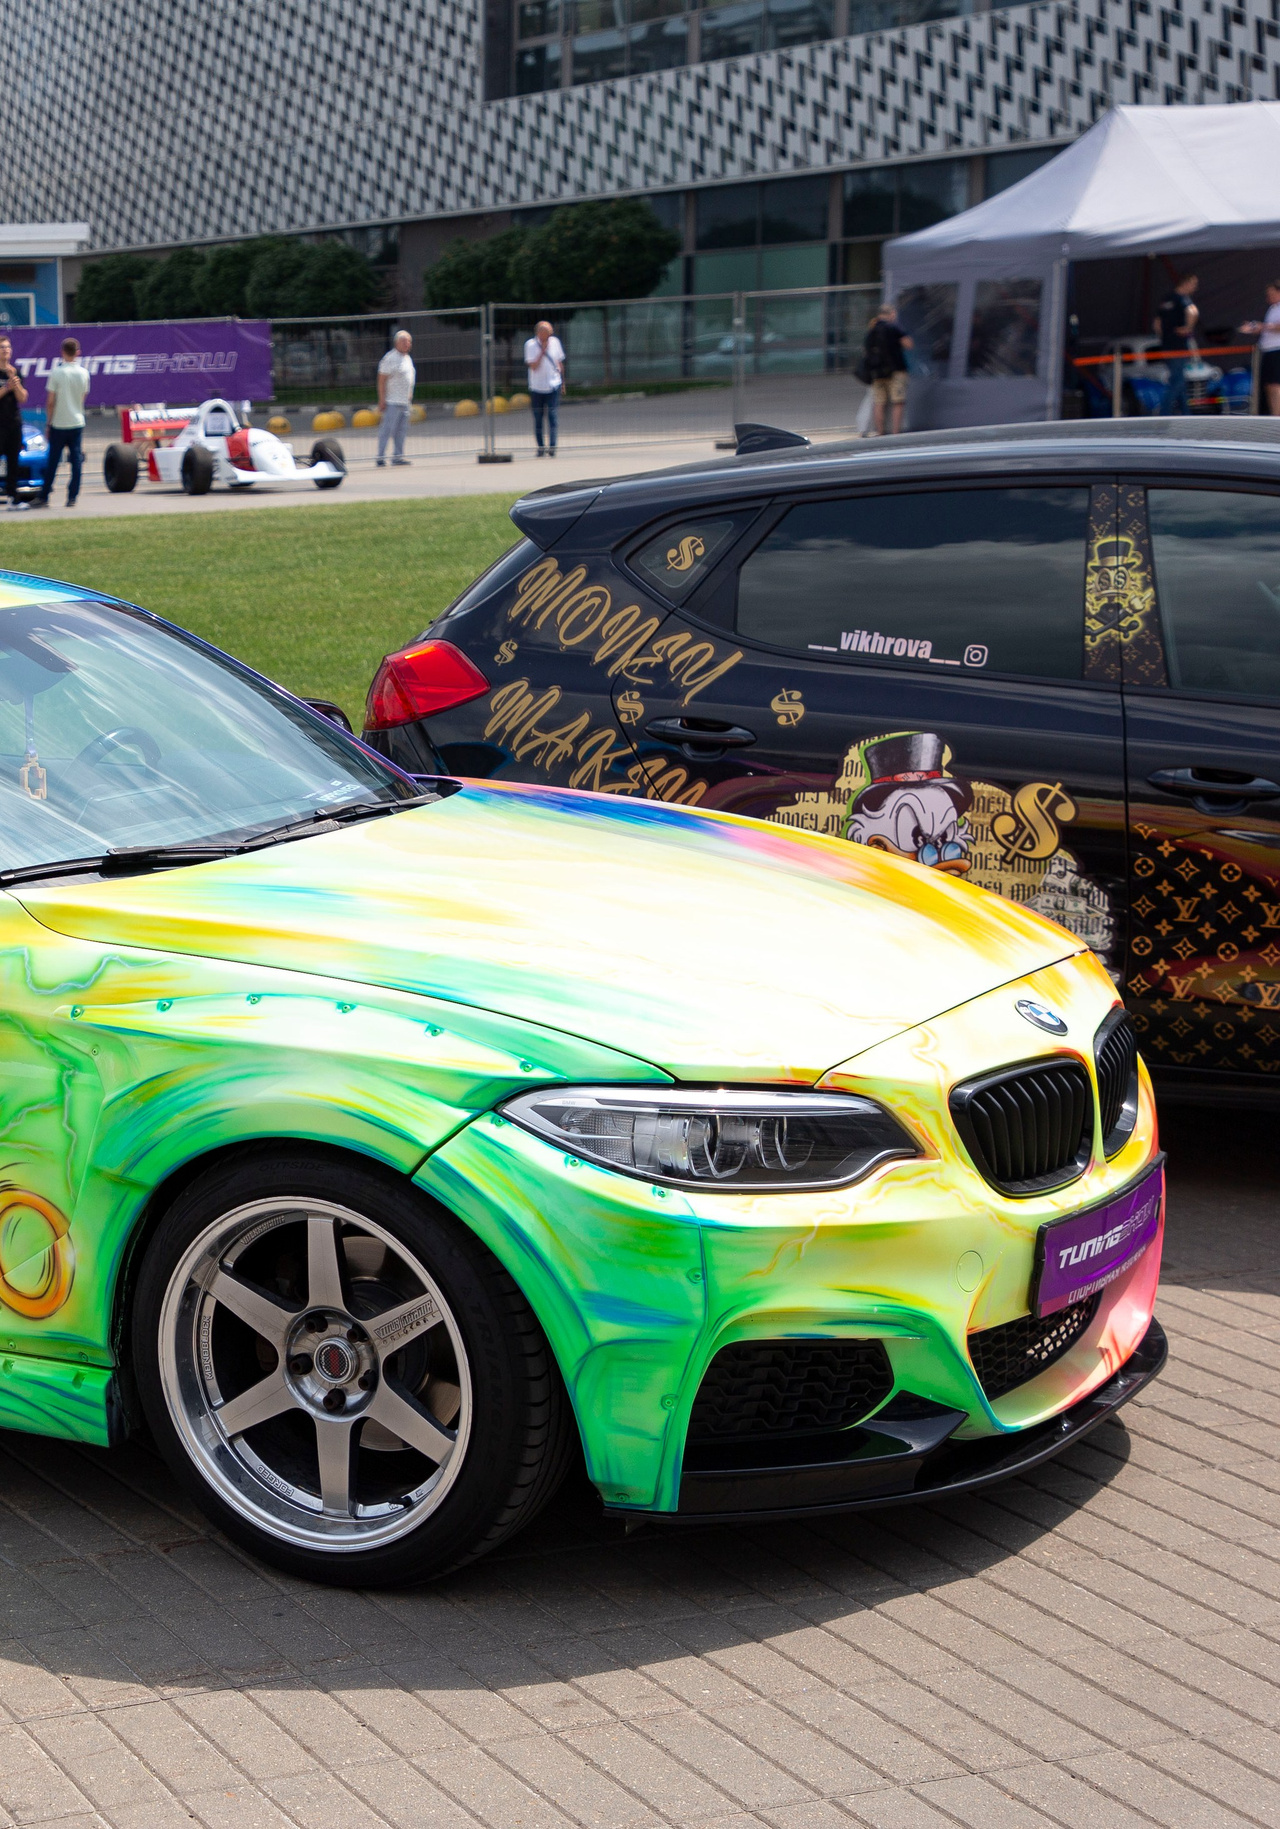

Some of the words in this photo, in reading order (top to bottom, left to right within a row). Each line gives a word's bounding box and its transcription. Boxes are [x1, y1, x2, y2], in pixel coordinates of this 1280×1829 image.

[14, 351, 239, 379] TUINGSHOW
[508, 556, 744, 708] MONEY
[256, 1464, 295, 1498] FORGED
